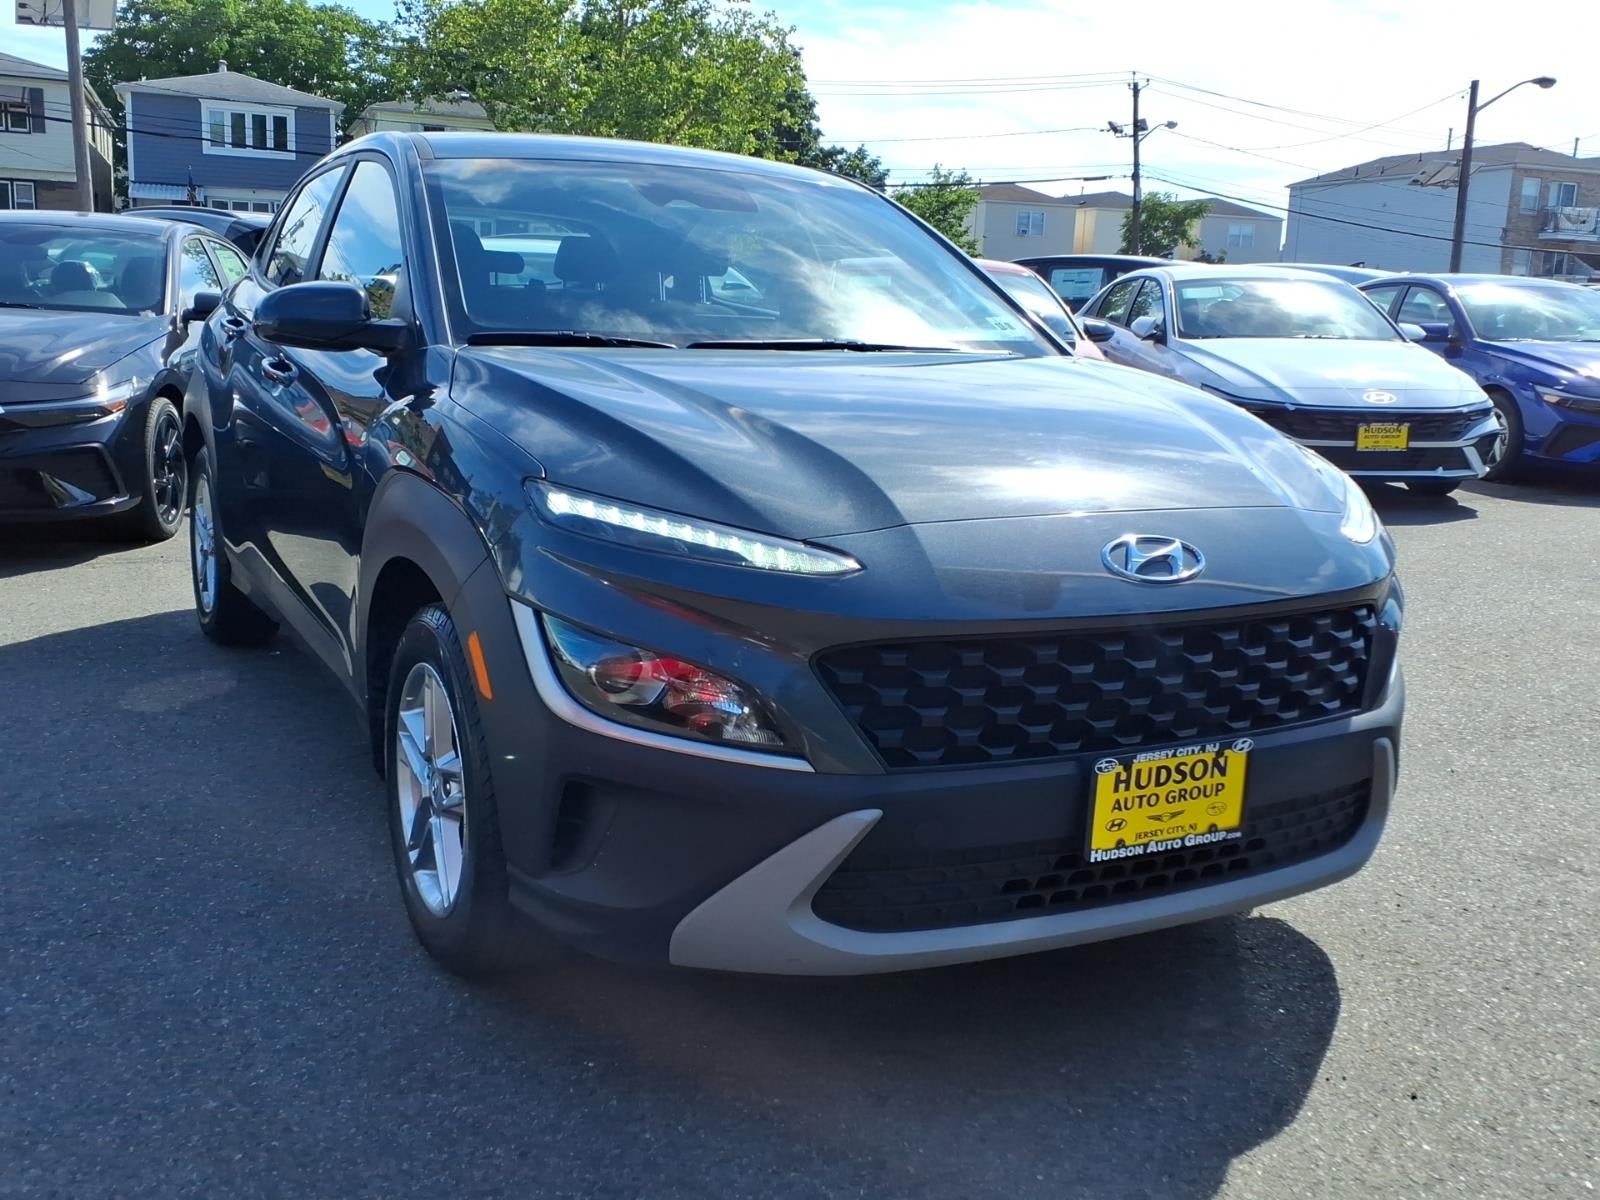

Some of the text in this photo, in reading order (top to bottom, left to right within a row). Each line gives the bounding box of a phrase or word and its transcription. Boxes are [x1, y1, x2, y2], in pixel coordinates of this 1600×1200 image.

[1133, 749, 1174, 763] JERSEY
[1205, 742, 1220, 752] NJ
[1113, 755, 1228, 793] HUDSON
[1111, 782, 1225, 813] AUTO GROUP
[1134, 828, 1165, 842] JERSEY
[1188, 823, 1198, 831] NJ
